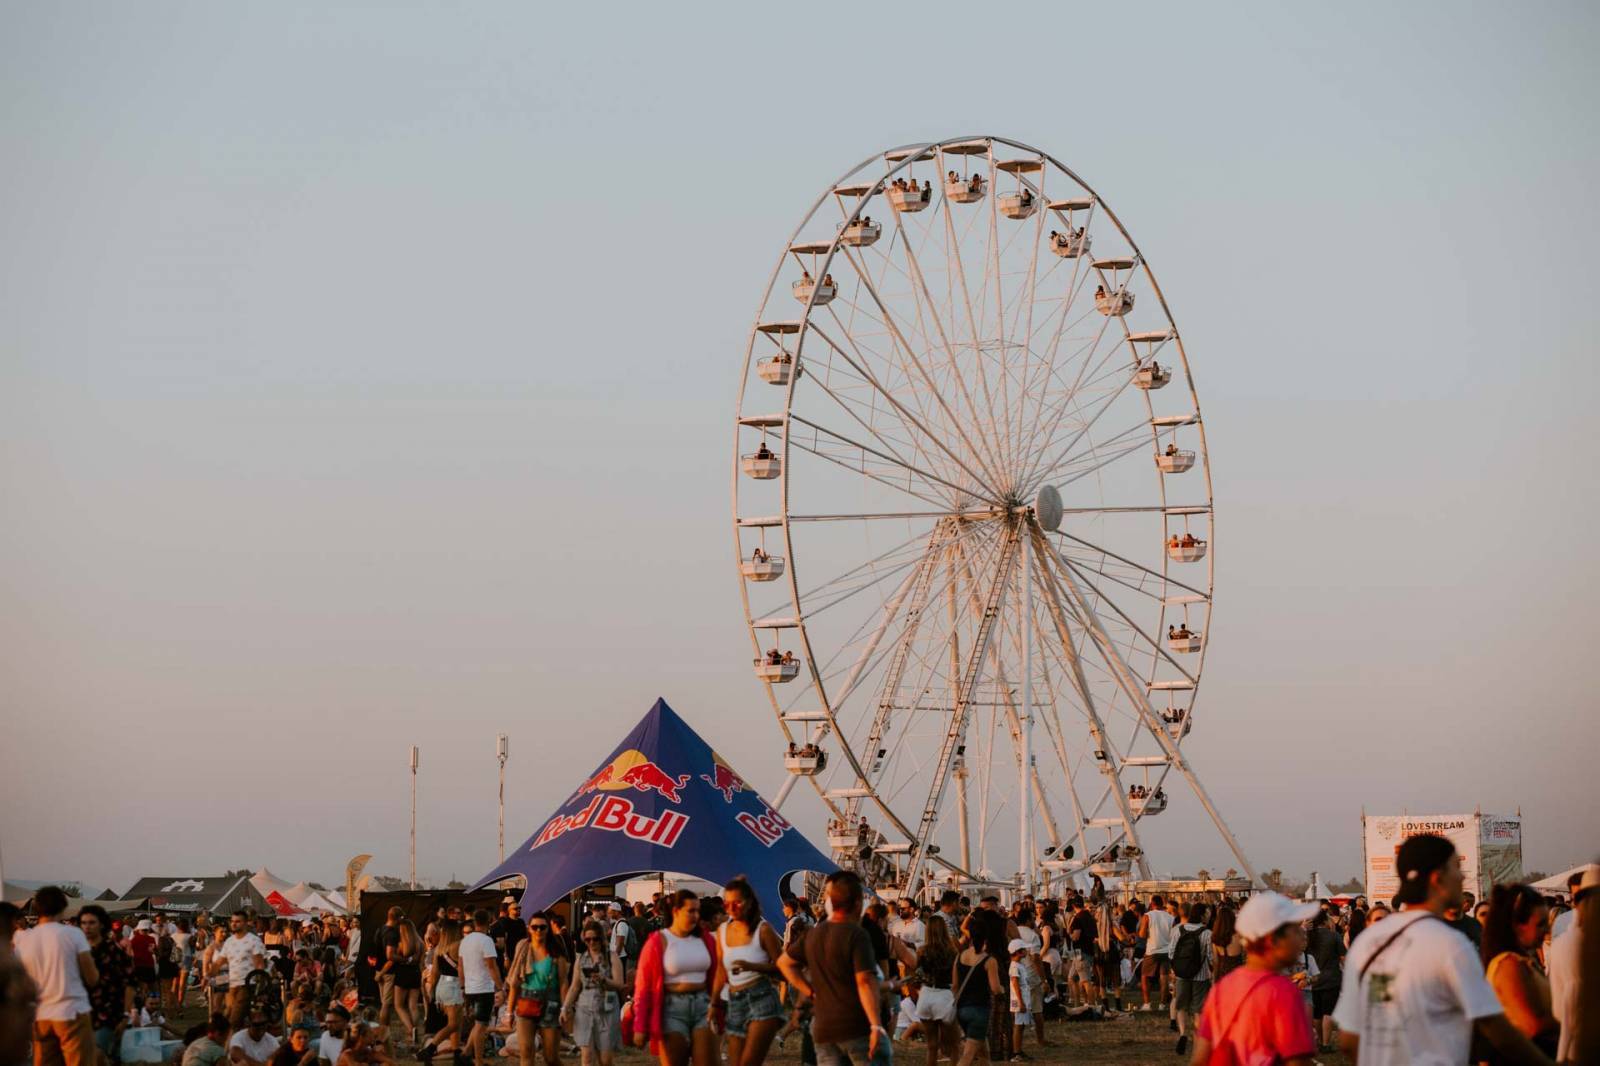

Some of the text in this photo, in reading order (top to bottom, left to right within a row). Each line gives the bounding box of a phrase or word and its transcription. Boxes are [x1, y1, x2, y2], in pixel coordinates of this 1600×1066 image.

[529, 793, 690, 851] Red Bull
[735, 795, 792, 848] Red
[1401, 821, 1465, 831] LOVESTREAM
